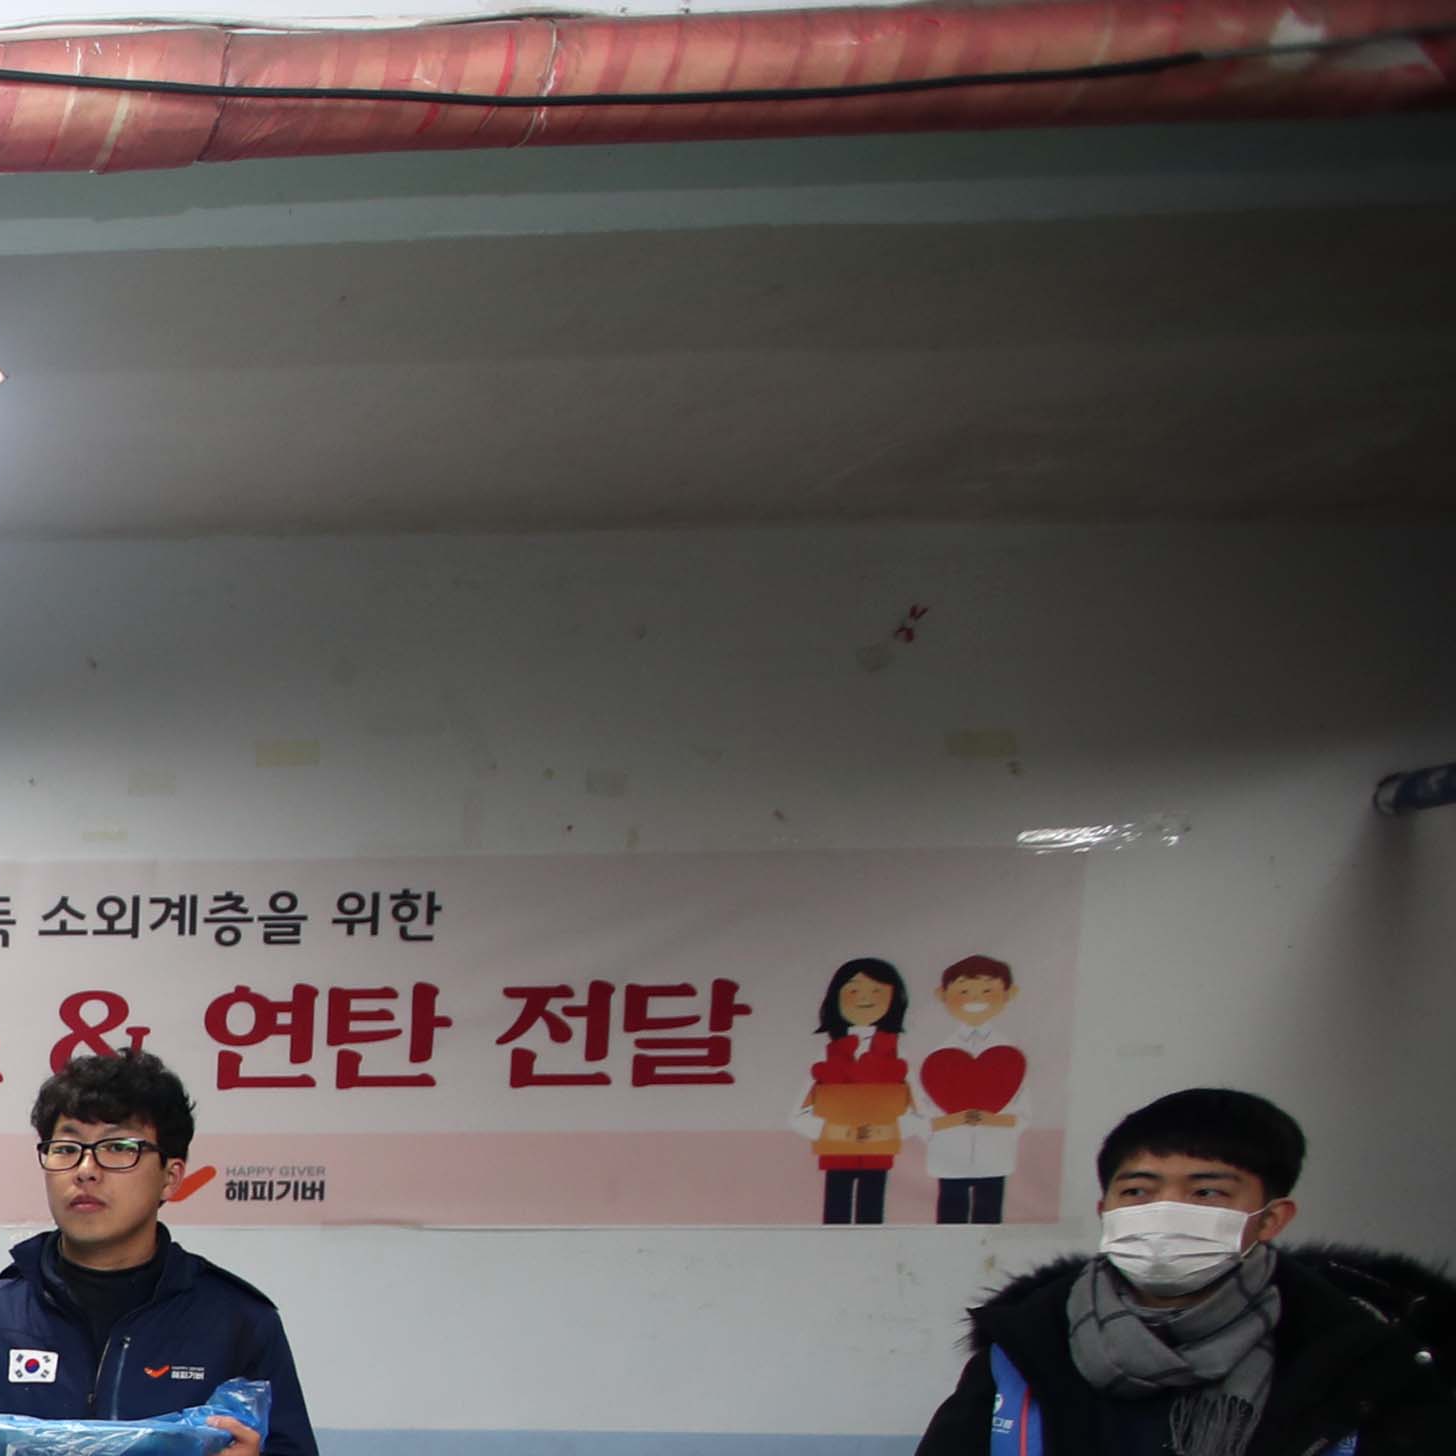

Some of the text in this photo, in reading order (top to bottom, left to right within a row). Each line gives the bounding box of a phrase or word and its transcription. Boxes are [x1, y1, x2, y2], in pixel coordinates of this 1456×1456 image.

[37, 890, 309, 947] 소외계층을
[331, 890, 442, 942] 위한
[49, 990, 151, 1080] &
[204, 982, 453, 1090] 연탄
[495, 978, 753, 1088] 전달
[225, 1165, 327, 1177] HAPPY GIVER
[225, 1179, 326, 1202] 해피기버
